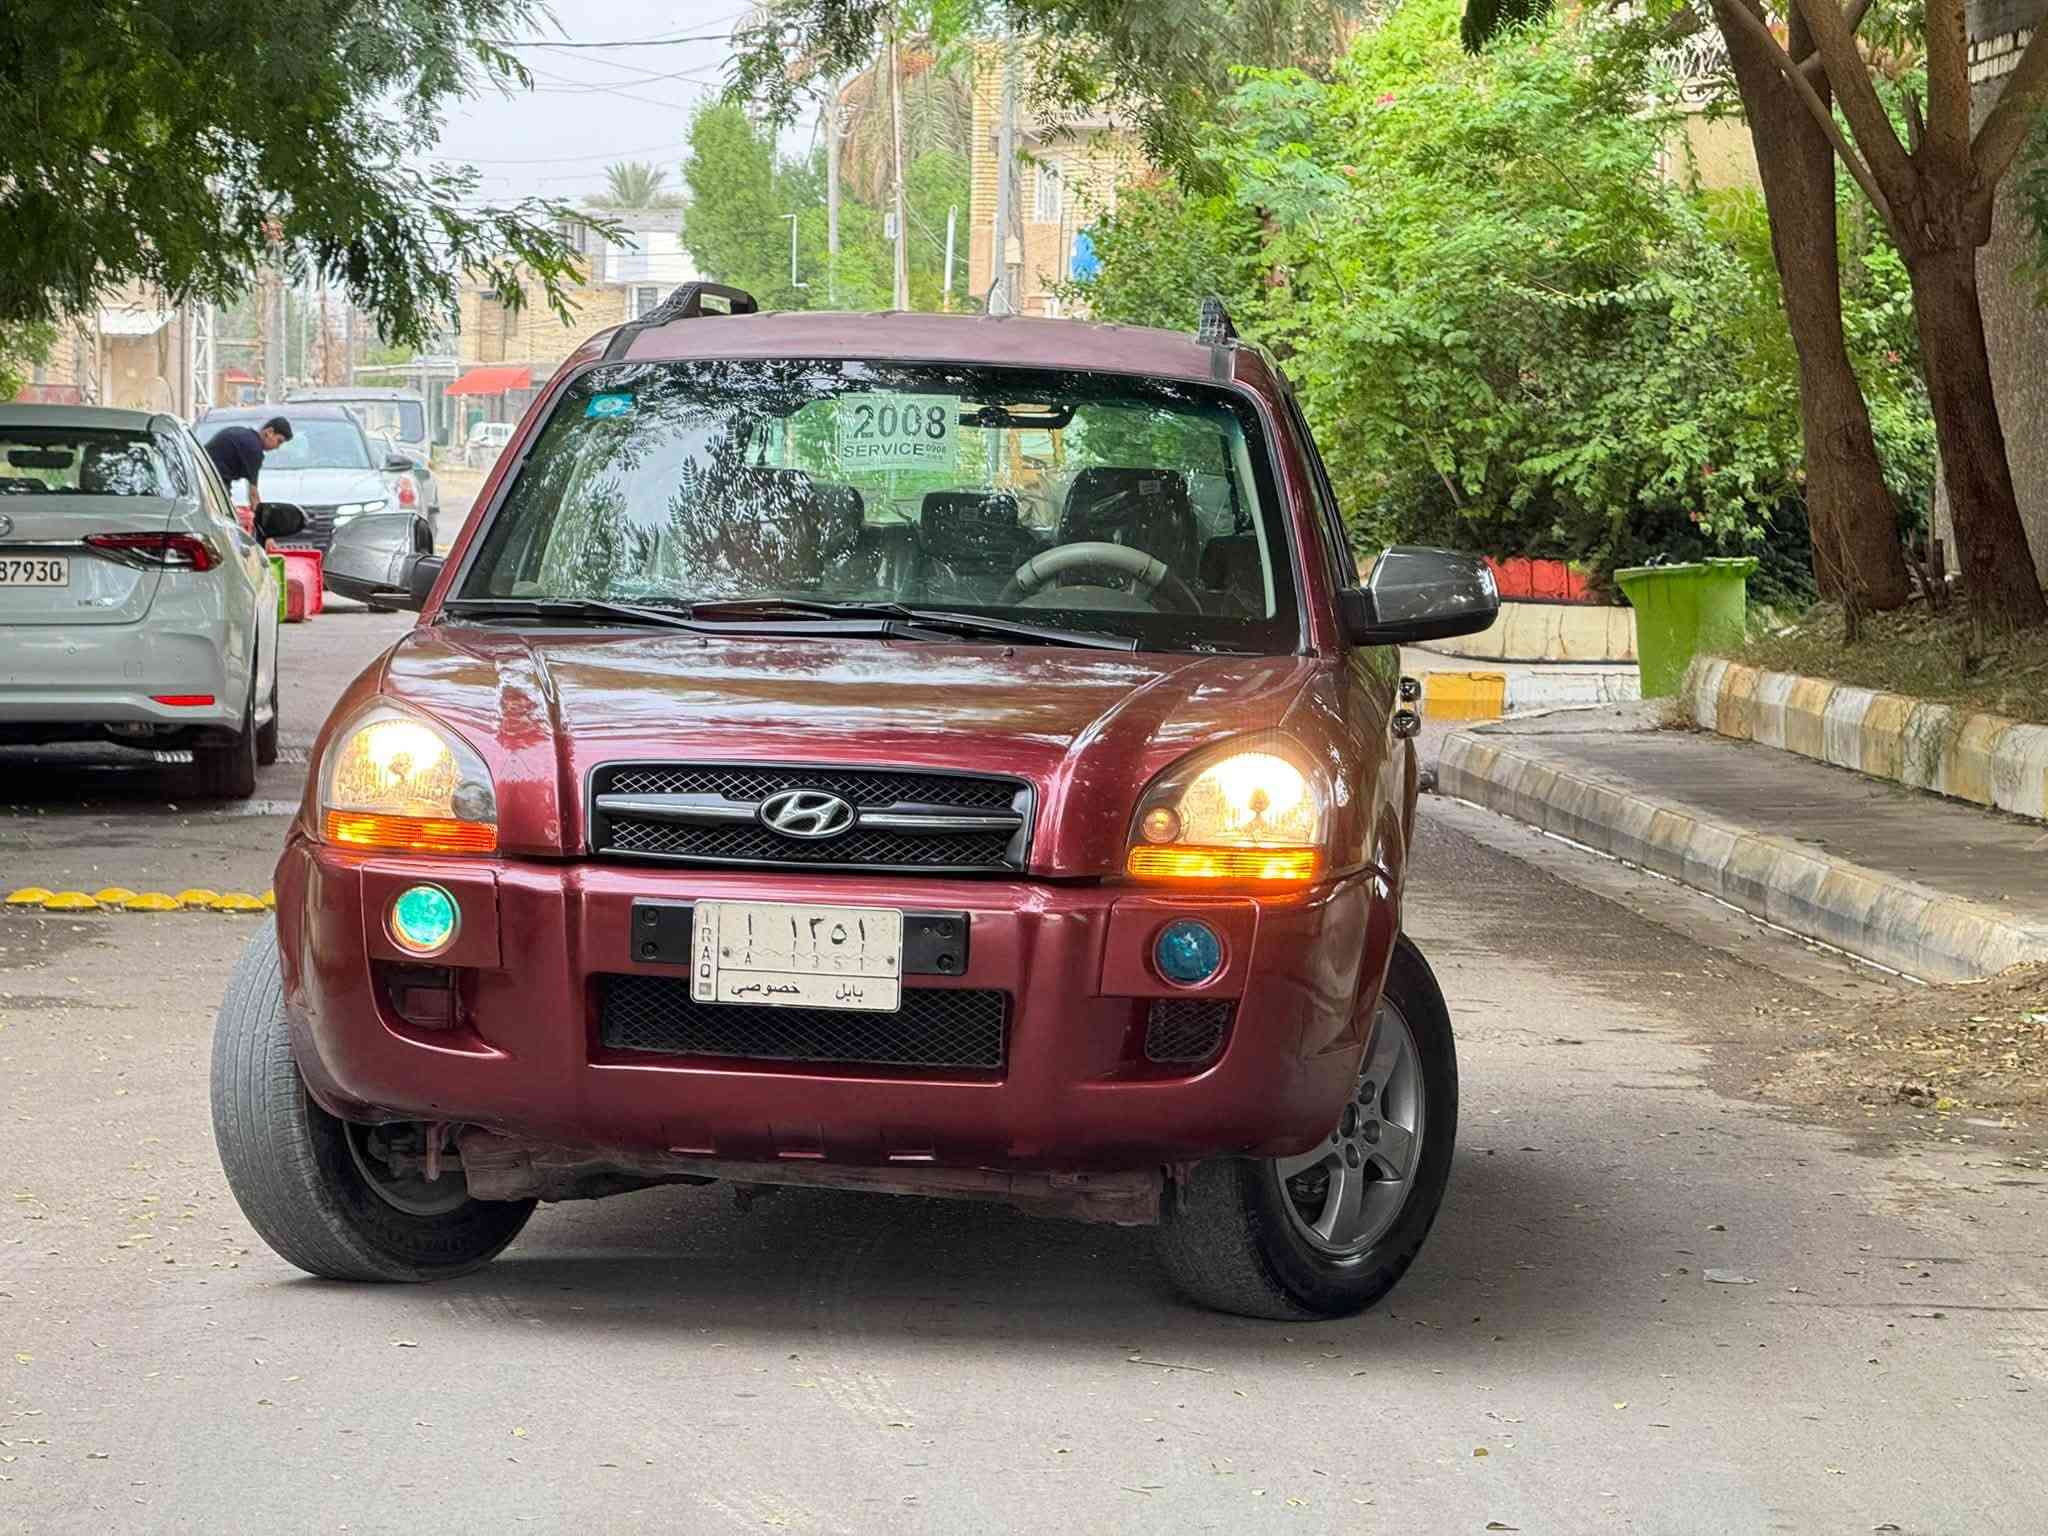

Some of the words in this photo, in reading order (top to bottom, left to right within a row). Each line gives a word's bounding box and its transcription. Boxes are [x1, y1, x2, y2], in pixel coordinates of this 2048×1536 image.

[853, 404, 946, 439] 2008
[843, 442, 925, 458] SERVICE
[700, 911, 712, 979] IRAQ
[730, 981, 801, 999] خصوصي
[834, 983, 864, 1003] بابل
